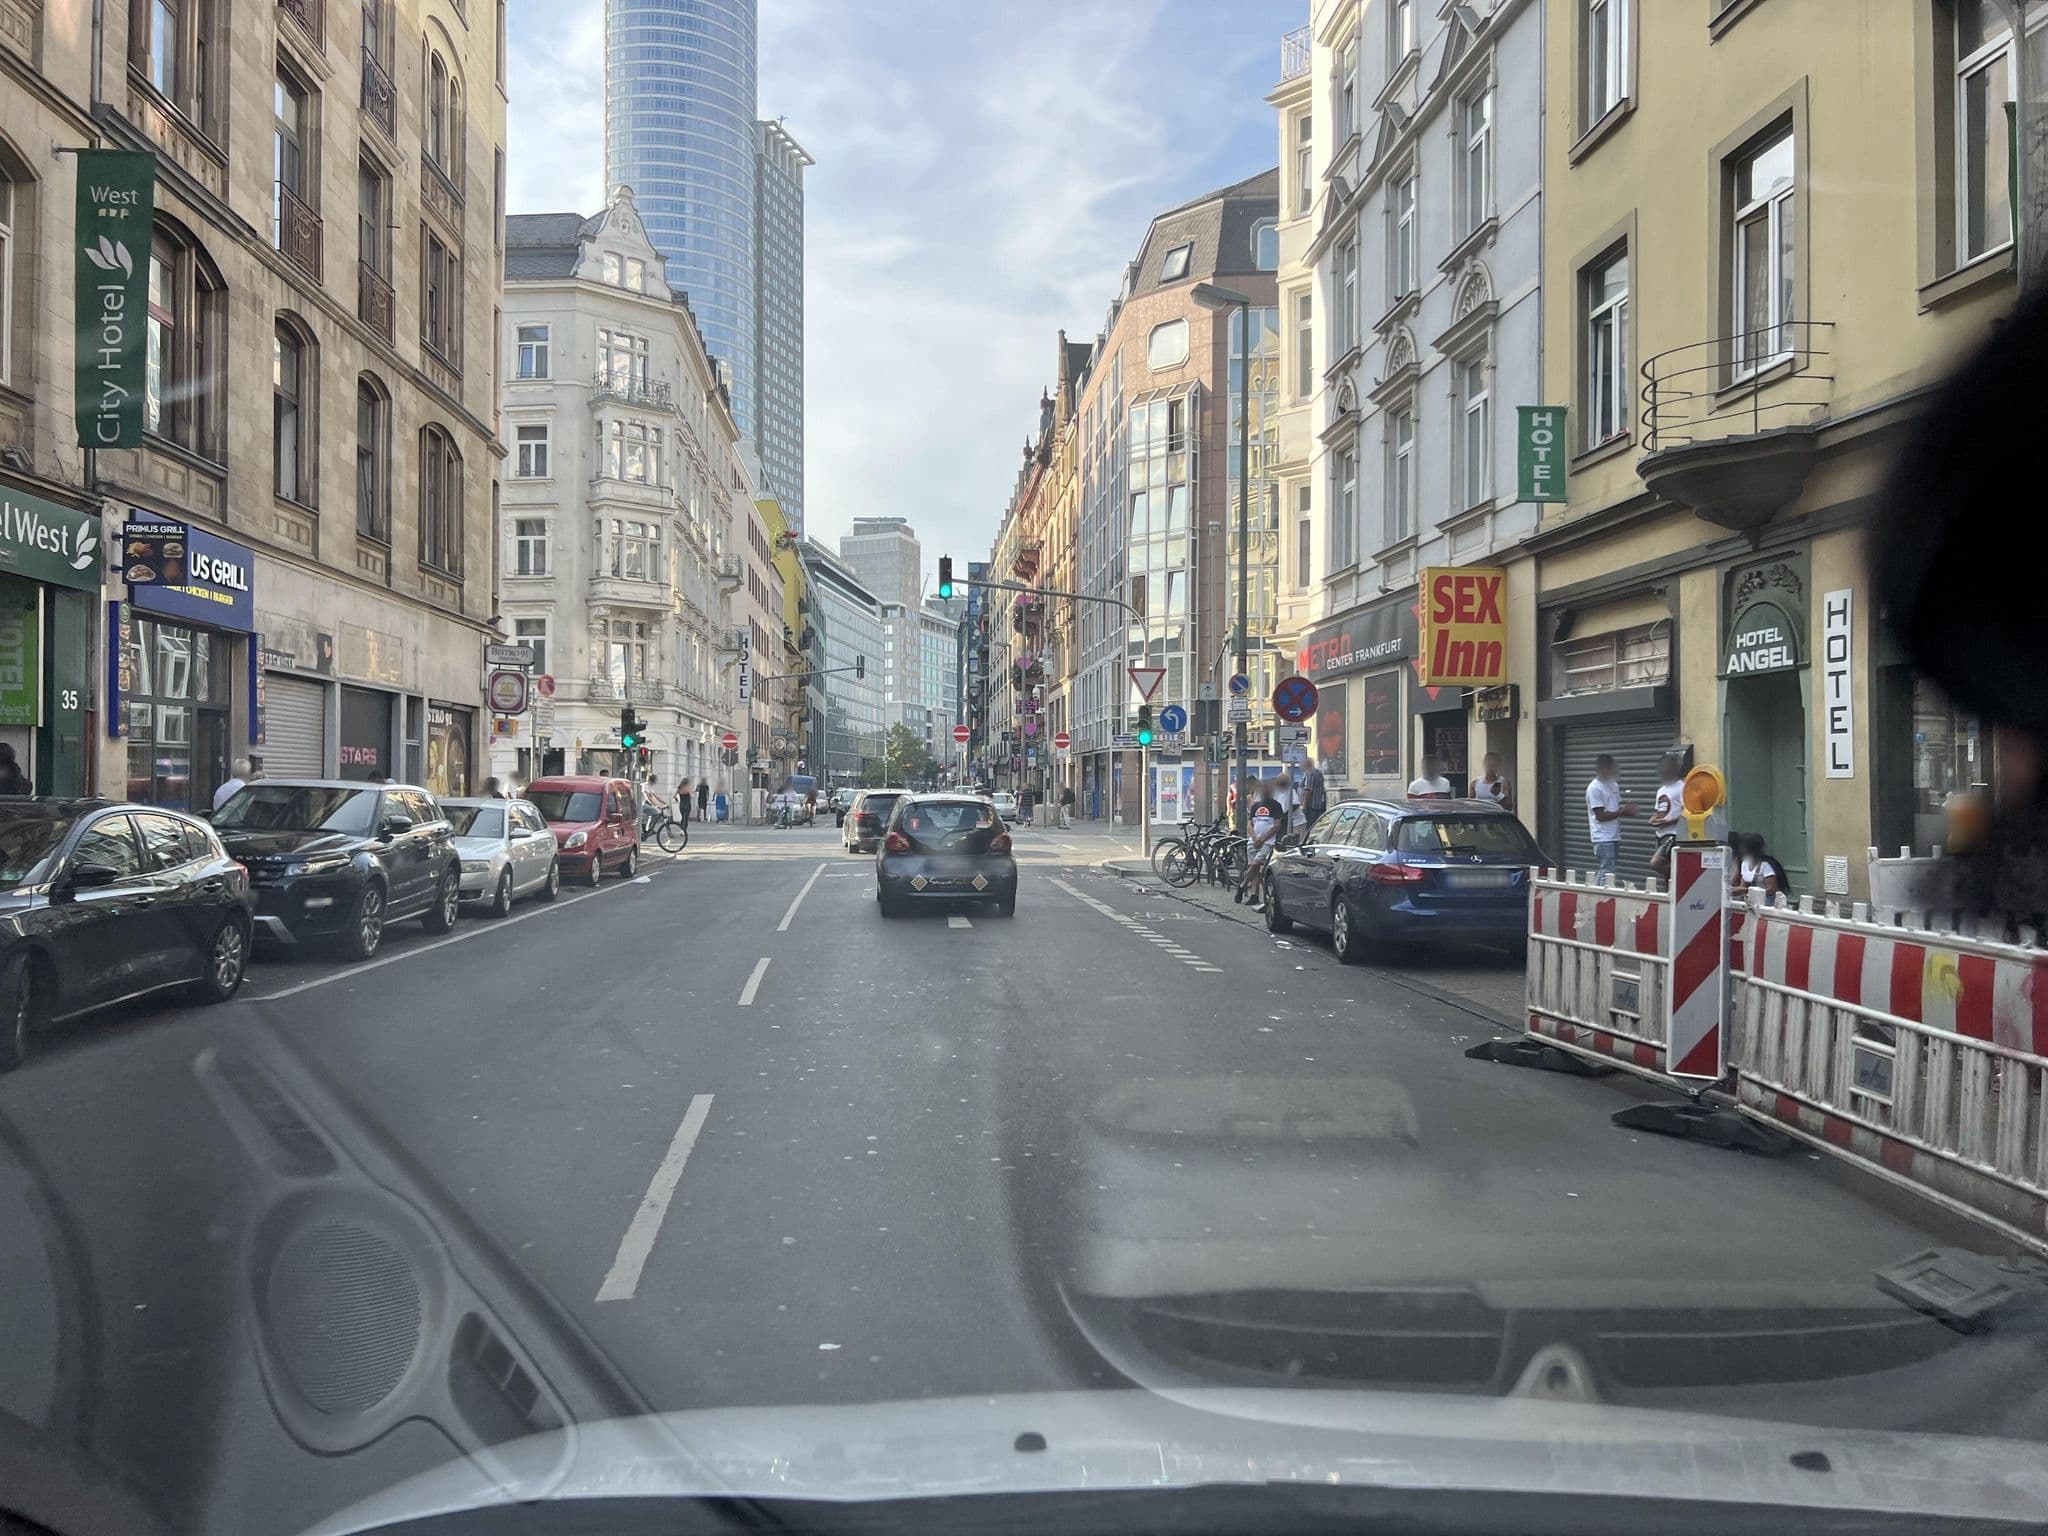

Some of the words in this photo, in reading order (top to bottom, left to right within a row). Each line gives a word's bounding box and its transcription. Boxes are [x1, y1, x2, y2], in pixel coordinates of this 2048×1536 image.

[90, 186, 139, 205] West
[98, 285, 125, 369] Hotel
[96, 380, 129, 443] City
[1531, 412, 1553, 497] HOTEL
[14, 507, 69, 556] West
[126, 524, 159, 533] PRIMUS
[160, 526, 185, 534] GRILL
[190, 551, 209, 580] US
[211, 558, 249, 592] GRILL
[1432, 575, 1503, 625] SEX
[1297, 632, 1353, 673] METRO
[1326, 653, 1354, 670] CENTER
[1355, 638, 1402, 662] FRANKFURT
[1431, 629, 1503, 678] Inn
[1736, 627, 1784, 649] HOTEL
[1726, 646, 1795, 674] ANGEL
[61, 690, 78, 710] 35
[1827, 598, 1849, 770] HOTEL
